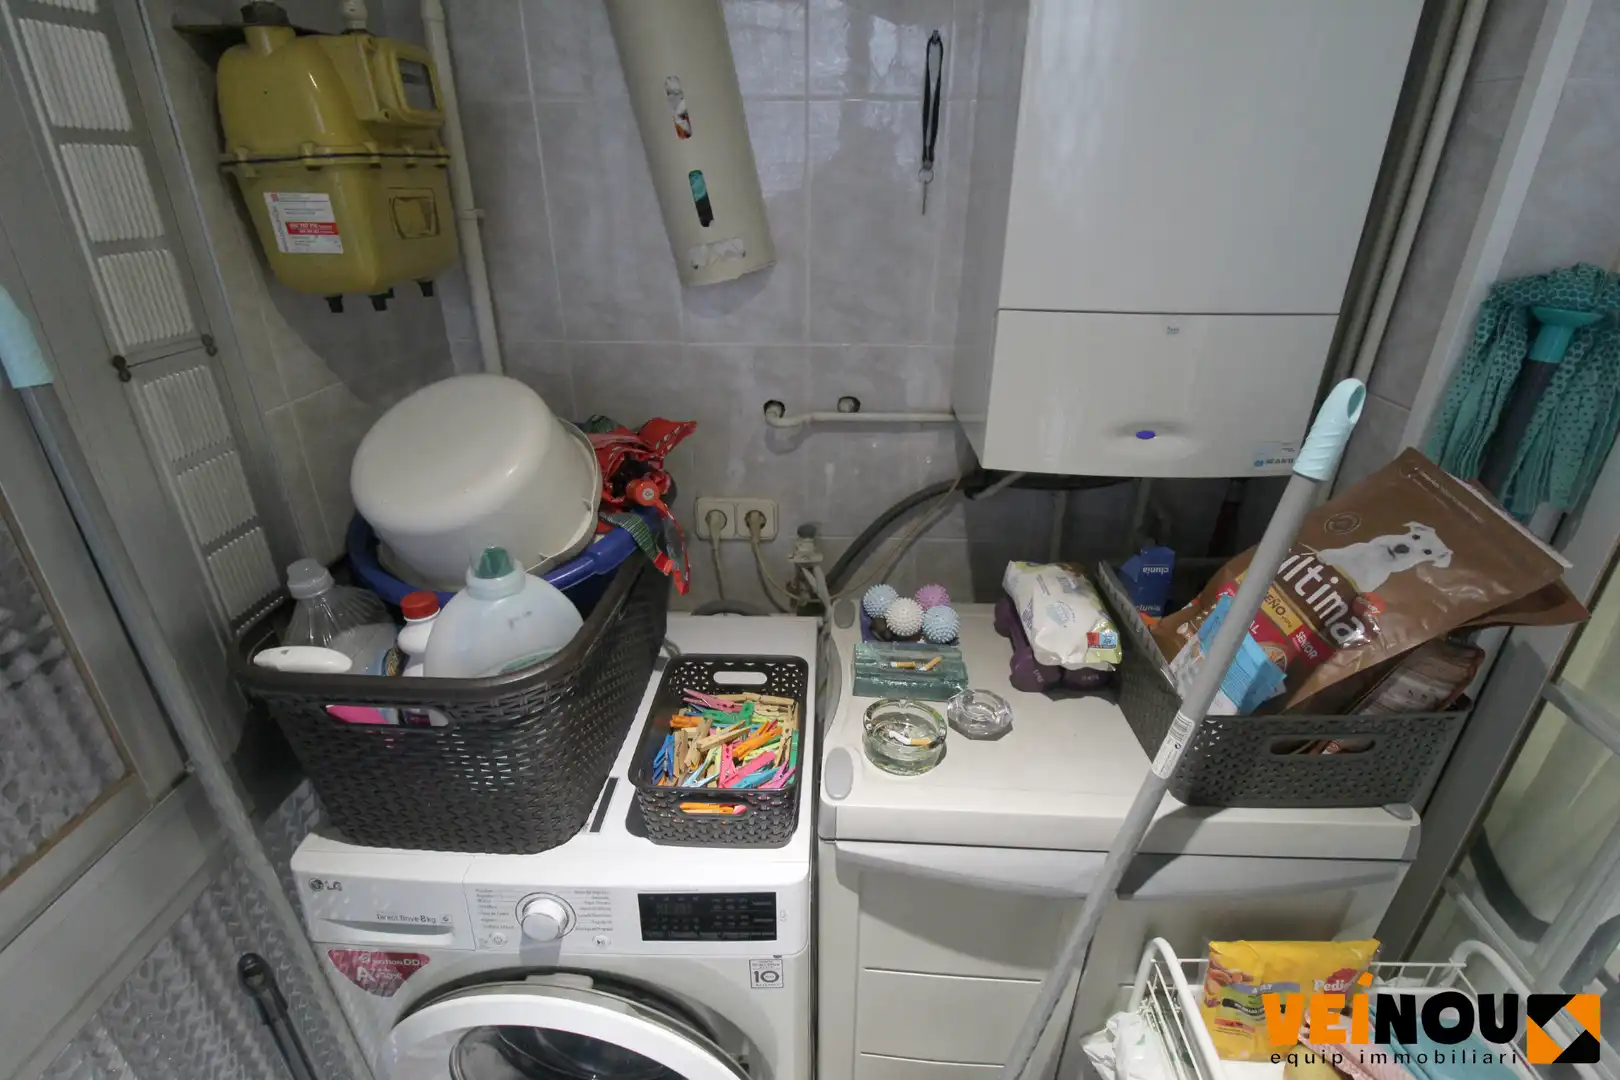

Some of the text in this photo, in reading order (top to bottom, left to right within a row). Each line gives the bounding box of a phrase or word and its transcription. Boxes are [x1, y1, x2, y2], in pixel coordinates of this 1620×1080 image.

[1295, 631, 1318, 659] SENIOR
[324, 880, 343, 891] LG
[753, 970, 780, 983] 10
